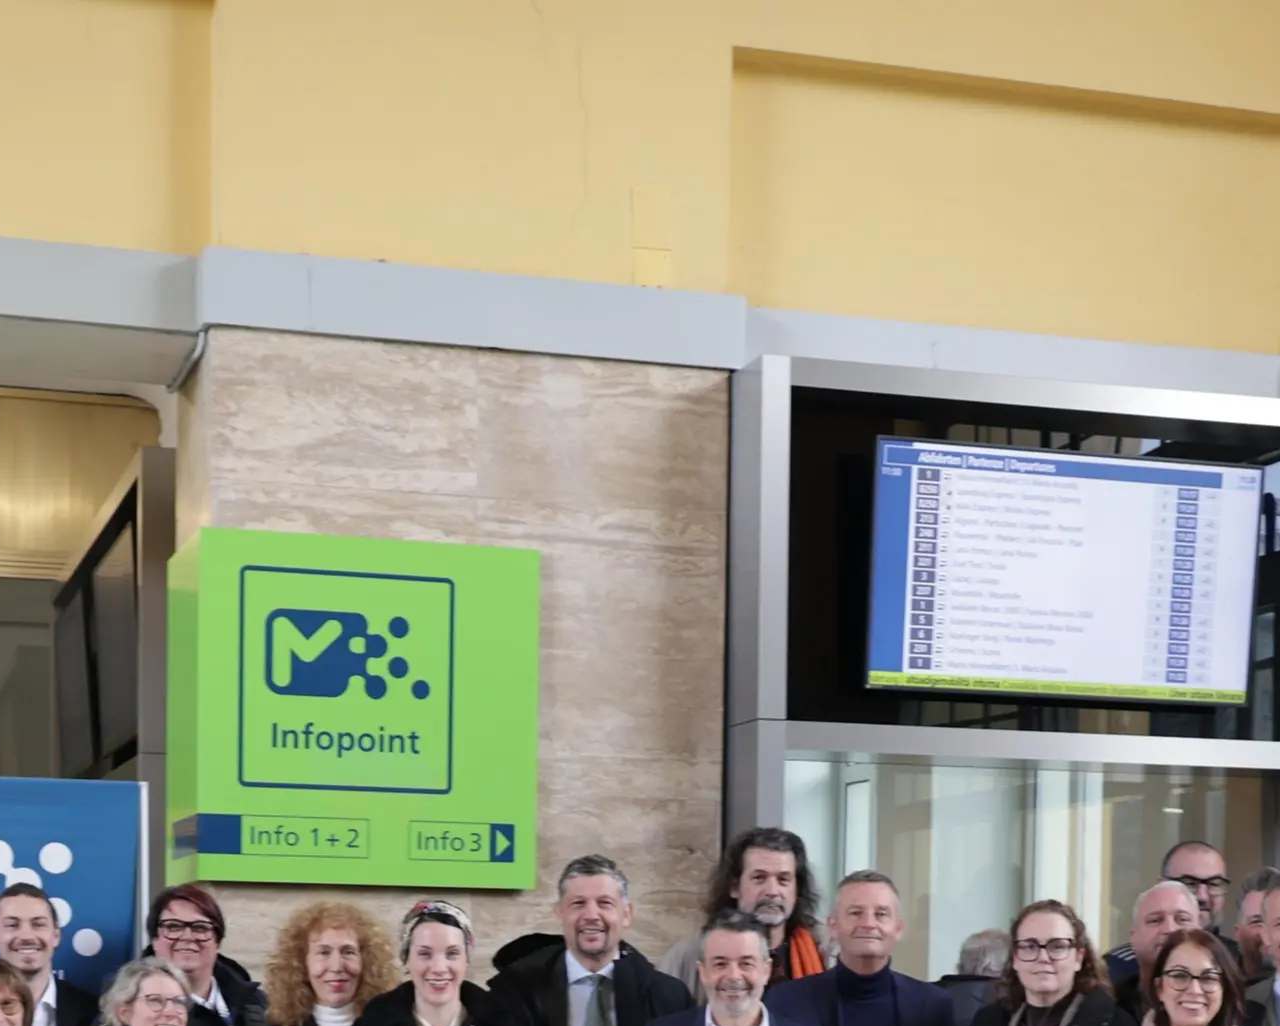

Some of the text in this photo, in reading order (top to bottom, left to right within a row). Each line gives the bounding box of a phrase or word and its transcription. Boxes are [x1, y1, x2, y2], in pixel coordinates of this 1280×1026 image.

[271, 722, 421, 758] Infopoint
[249, 824, 300, 847] Info
[415, 830, 465, 852] Info
